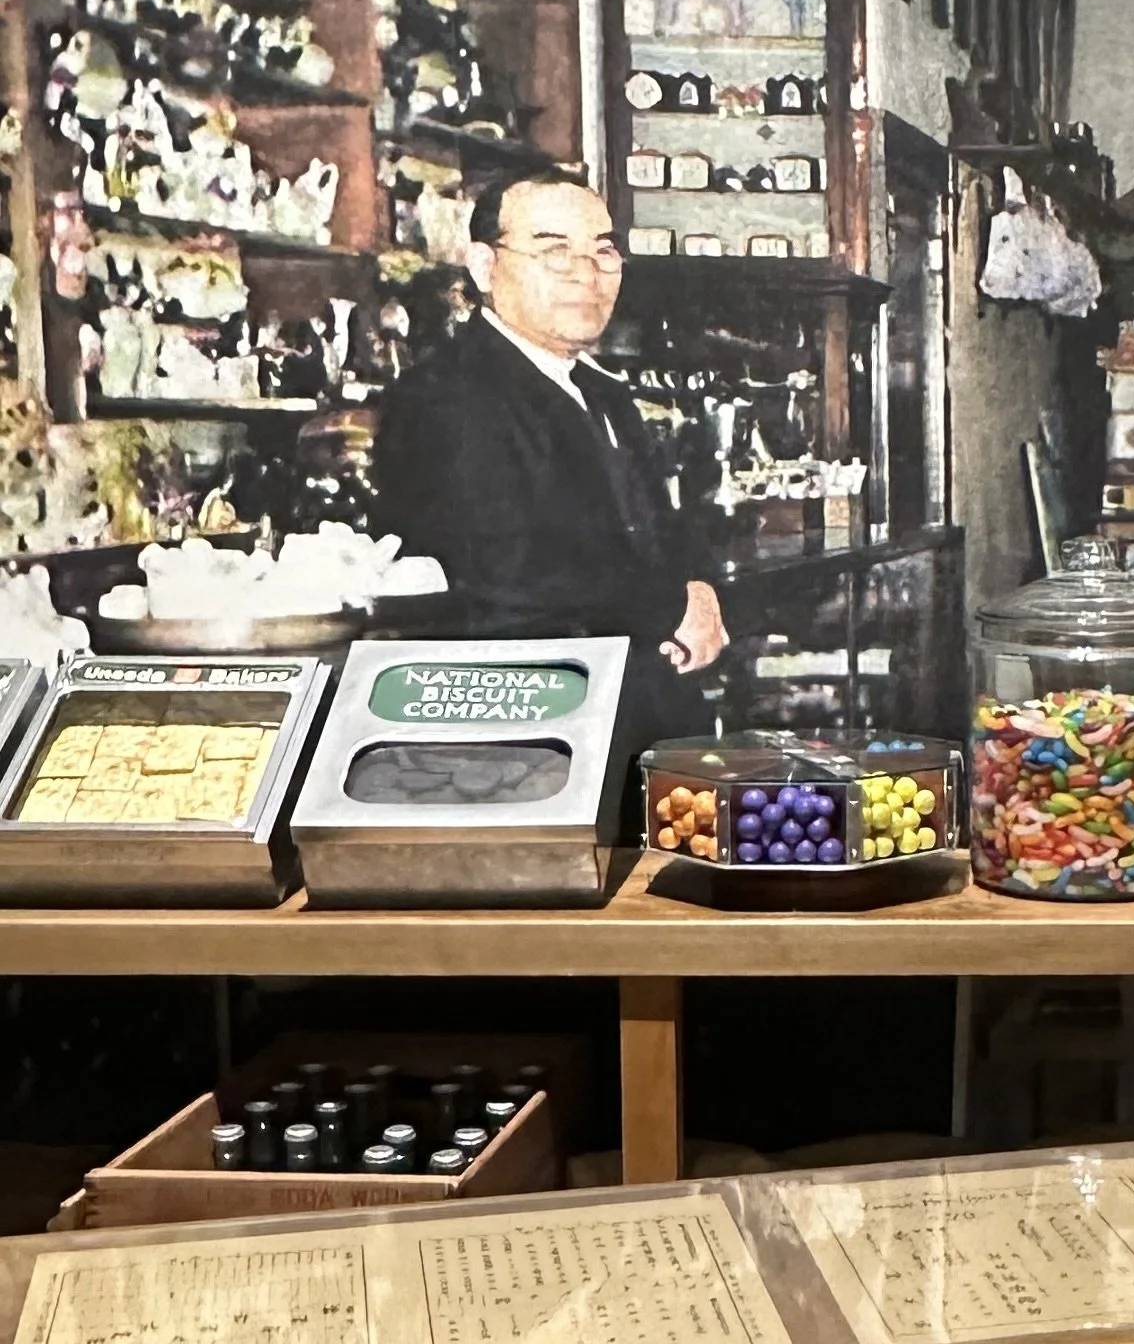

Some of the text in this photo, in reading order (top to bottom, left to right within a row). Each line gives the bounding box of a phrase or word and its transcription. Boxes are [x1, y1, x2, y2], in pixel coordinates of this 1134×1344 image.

[406, 668, 564, 689] NATIONAL
[421, 687, 538, 703] BISCUIT
[403, 702, 549, 720] COMPANY
